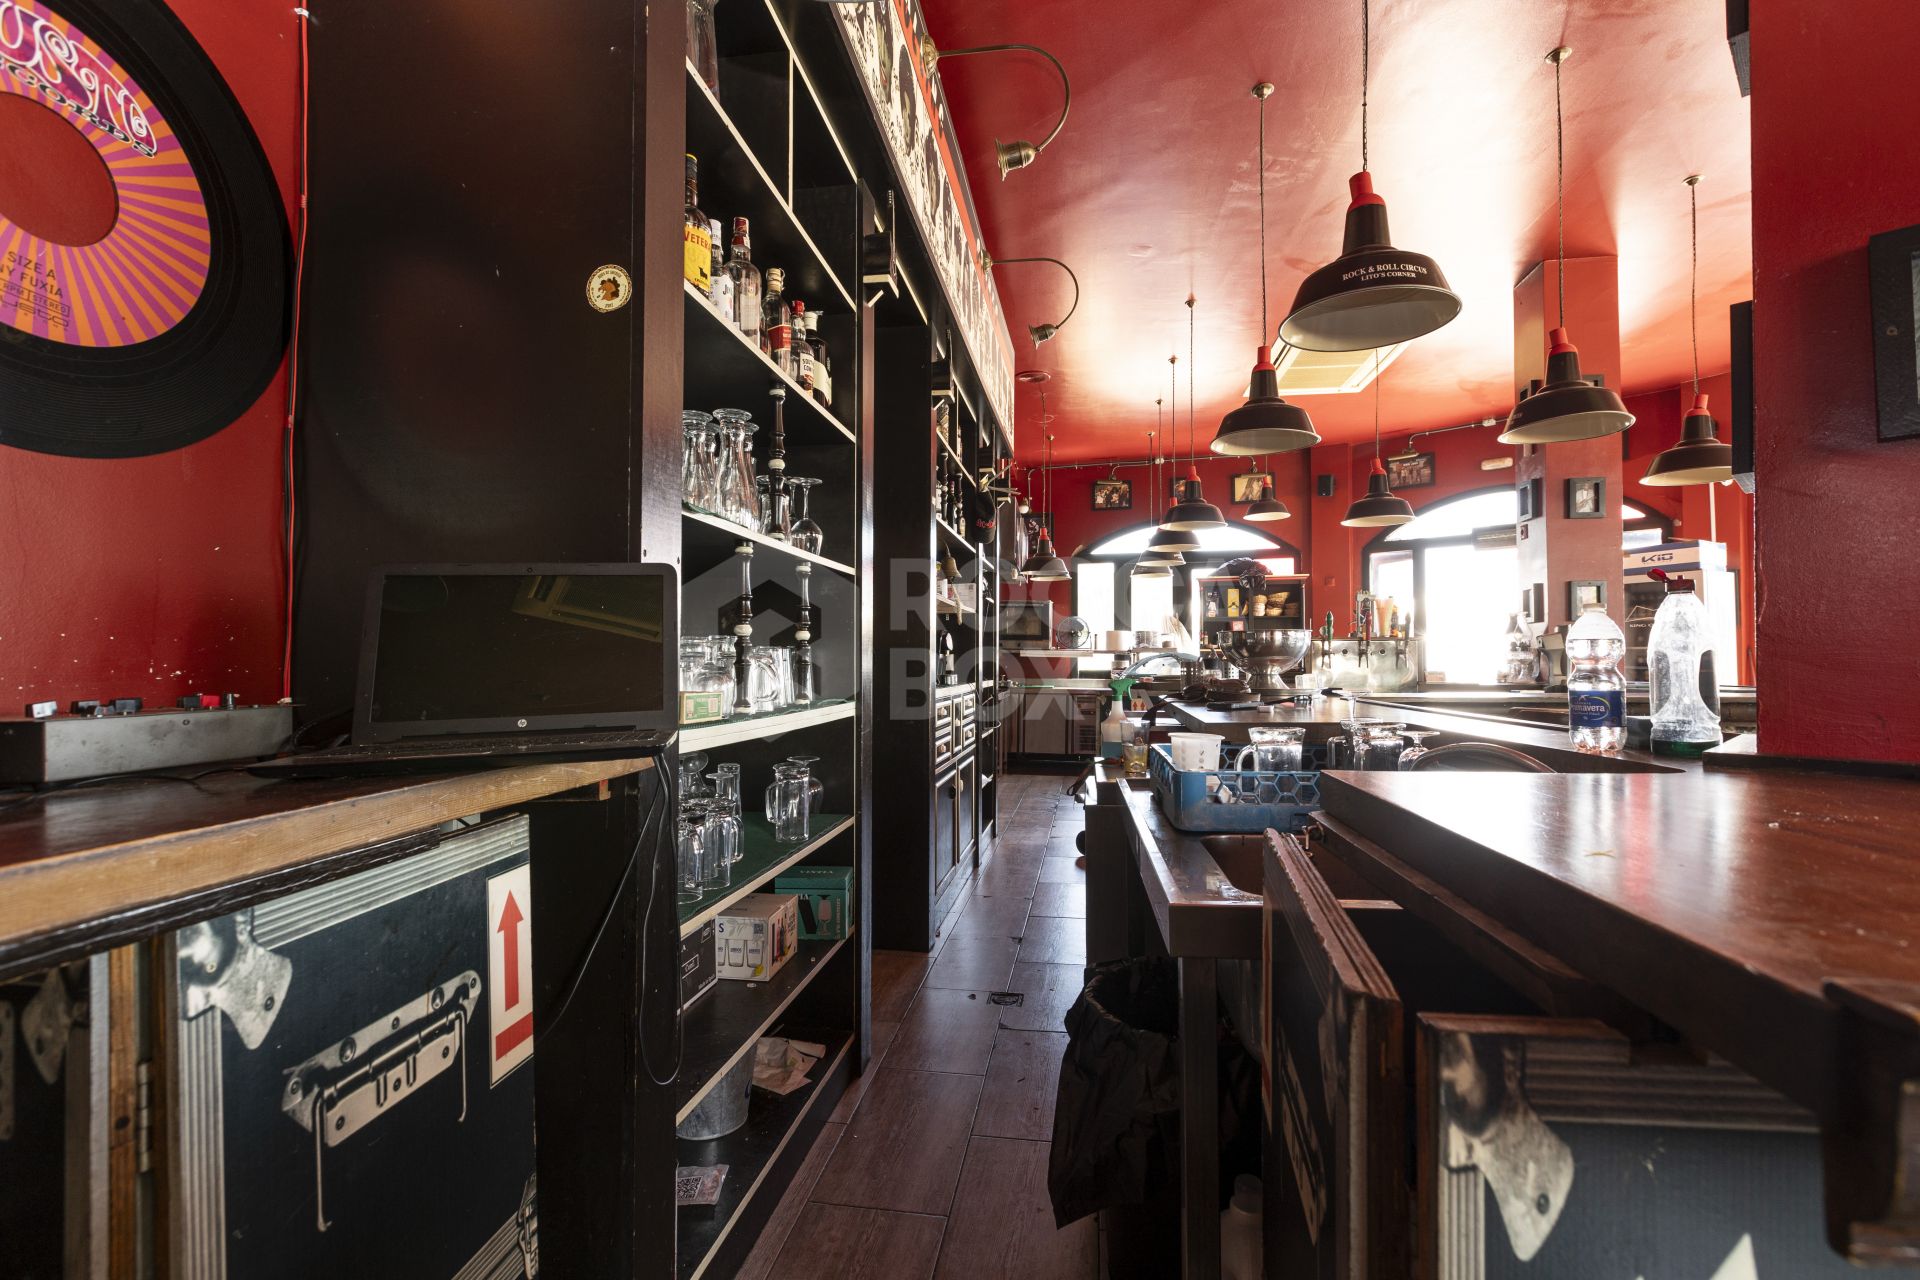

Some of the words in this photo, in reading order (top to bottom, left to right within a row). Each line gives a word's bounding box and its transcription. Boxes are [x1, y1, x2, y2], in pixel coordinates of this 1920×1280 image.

[0, 54, 156, 159] CORDS
[7, 251, 43, 275] SIZE
[46, 269, 56, 281] A
[1342, 268, 1366, 281] ROCK
[1376, 263, 1400, 272] ROLL
[1400, 263, 1428, 275] CIRCUS
[1361, 271, 1386, 281] LITO'S
[20, 272, 64, 299] FUXIA
